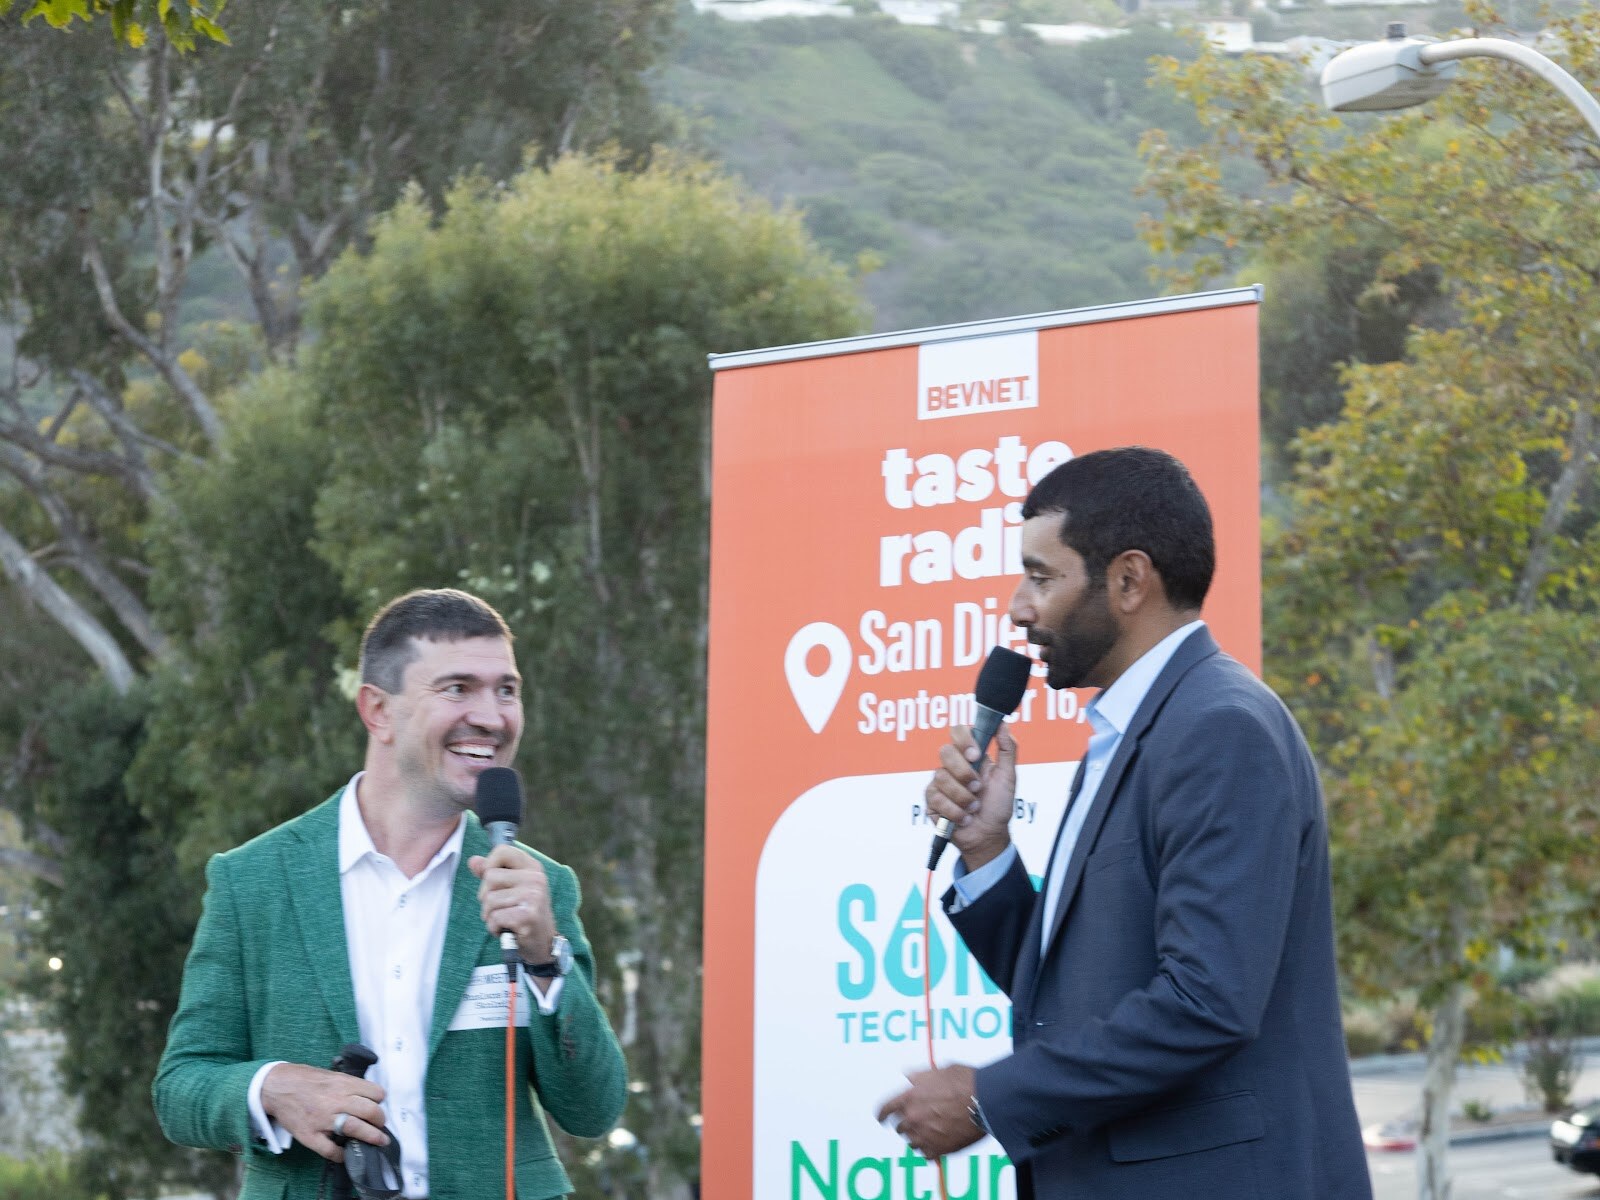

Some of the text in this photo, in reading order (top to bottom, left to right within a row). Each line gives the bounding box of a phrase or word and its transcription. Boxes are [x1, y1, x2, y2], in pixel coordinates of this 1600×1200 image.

[927, 375, 1029, 412] BEVNET
[879, 501, 1024, 587] radi
[858, 609, 943, 676] San
[857, 687, 1037, 742] Septemr
[836, 1005, 1013, 1044] TECHNO
